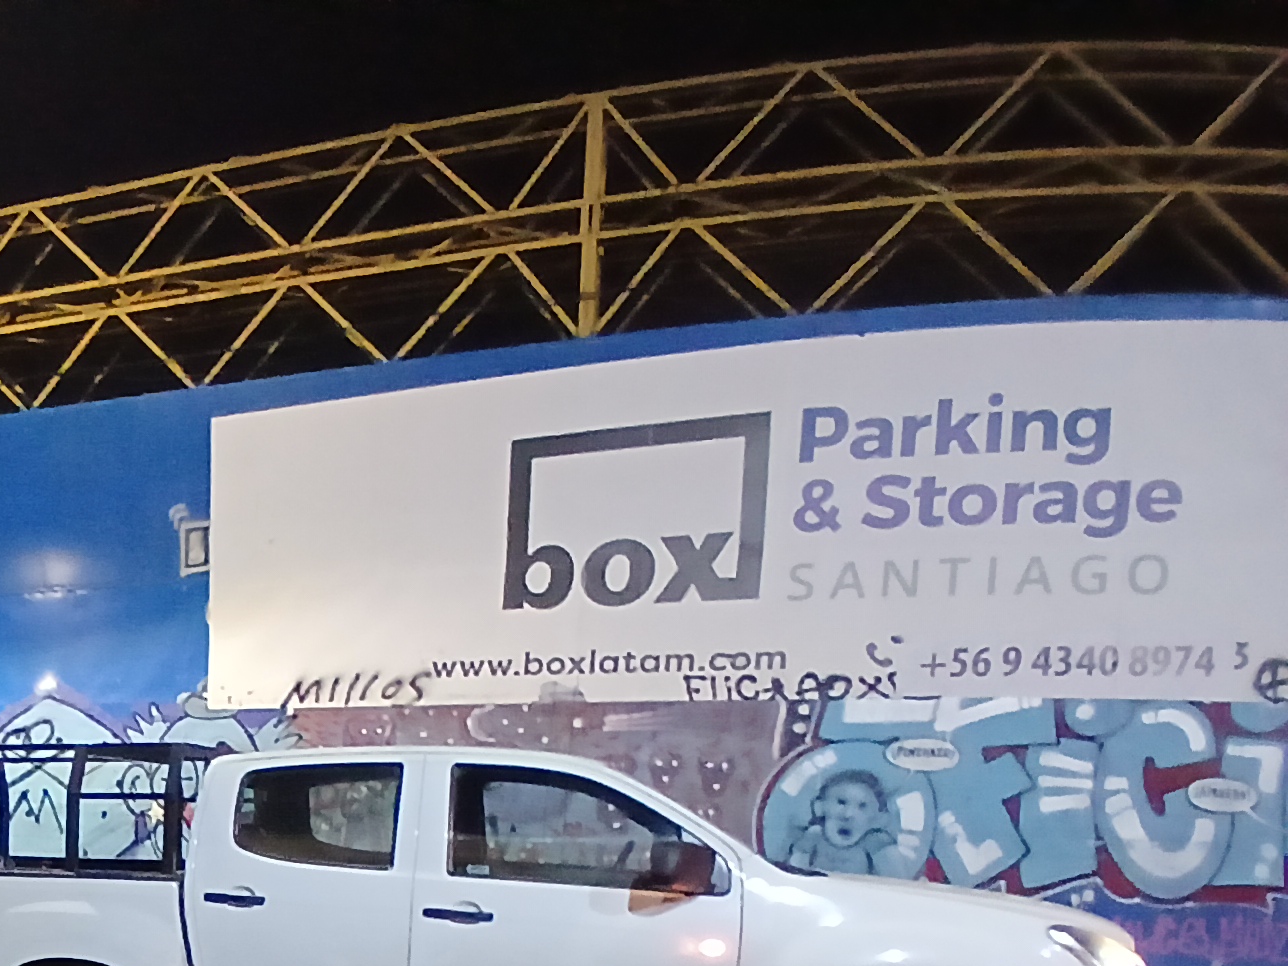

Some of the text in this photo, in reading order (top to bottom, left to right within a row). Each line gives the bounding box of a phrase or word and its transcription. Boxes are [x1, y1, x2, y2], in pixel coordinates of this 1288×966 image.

[797, 393, 1112, 466] Parking
[792, 473, 1185, 539] & Storage
[502, 530, 740, 610] box
[786, 553, 1171, 601] SANTIAGO
[431, 649, 788, 679] www.boxlatam.com
[919, 644, 1216, 678] +56 9 4340 8974
